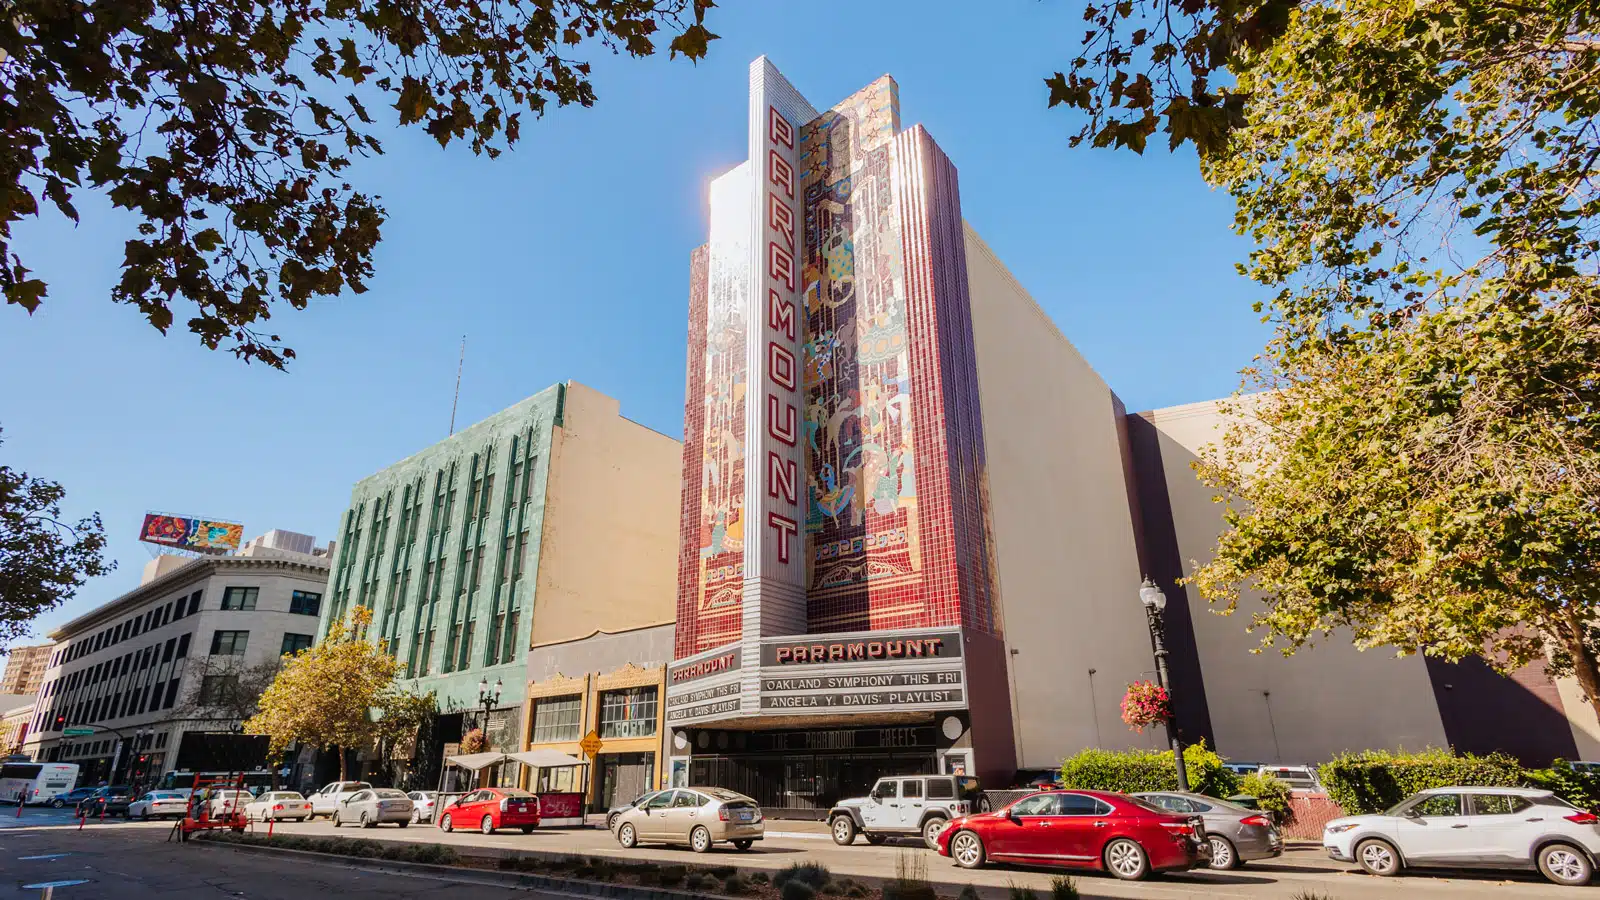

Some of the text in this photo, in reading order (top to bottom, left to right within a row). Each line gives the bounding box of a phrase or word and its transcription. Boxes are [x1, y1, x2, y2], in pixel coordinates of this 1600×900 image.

[768, 104, 798, 564] PARAMOUNT
[776, 638, 943, 664] PARAMOUNT
[672, 653, 736, 683] PARAMOUNT
[766, 672, 957, 691] OAKLAND SYMPHONY THIS FRI
[669, 683, 739, 706] OAKLAND SYMPHONY THIS FRI
[770, 690, 950, 707] ANGELA Y. DAVIS: PLAYLIST
[670, 709, 687, 720] ANGELA
[711, 700, 737, 714] PLAYLIST
